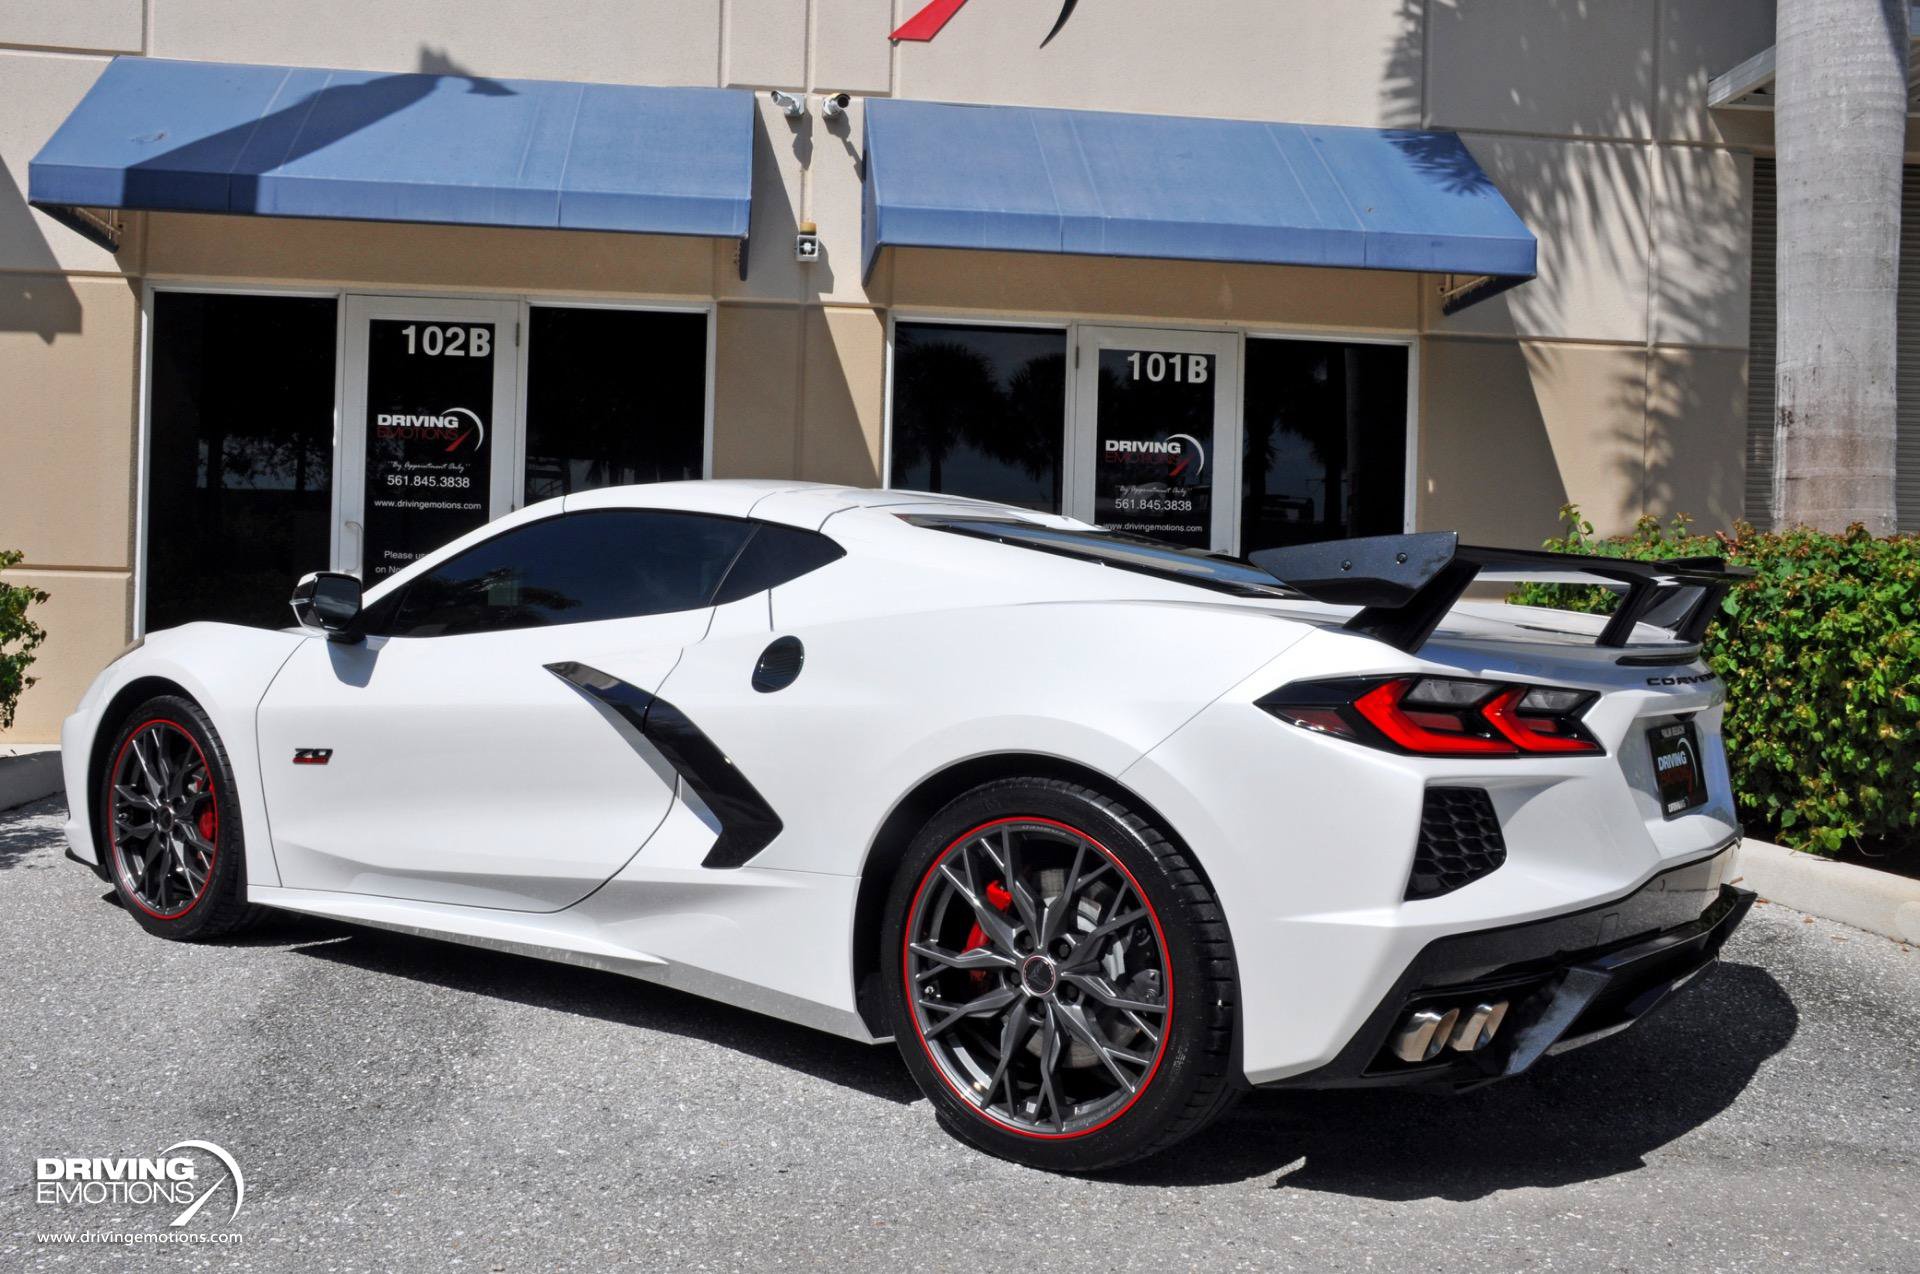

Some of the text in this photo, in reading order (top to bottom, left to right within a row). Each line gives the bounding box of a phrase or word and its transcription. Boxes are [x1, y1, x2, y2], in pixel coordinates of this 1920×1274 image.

[401, 325, 491, 358] 102B
[1127, 352, 1208, 384] 101B
[376, 413, 459, 429] DRIVING
[376, 427, 458, 440] EMOTIONS
[1105, 439, 1181, 455] DRIVING
[386, 474, 471, 489] 561.845.3838
[374, 498, 482, 511] www.drivingemotions.com
[1114, 498, 1193, 512] 561.845.3838
[383, 550, 413, 561] Please
[375, 566, 387, 574] on
[1657, 750, 1688, 772] DRIVING
